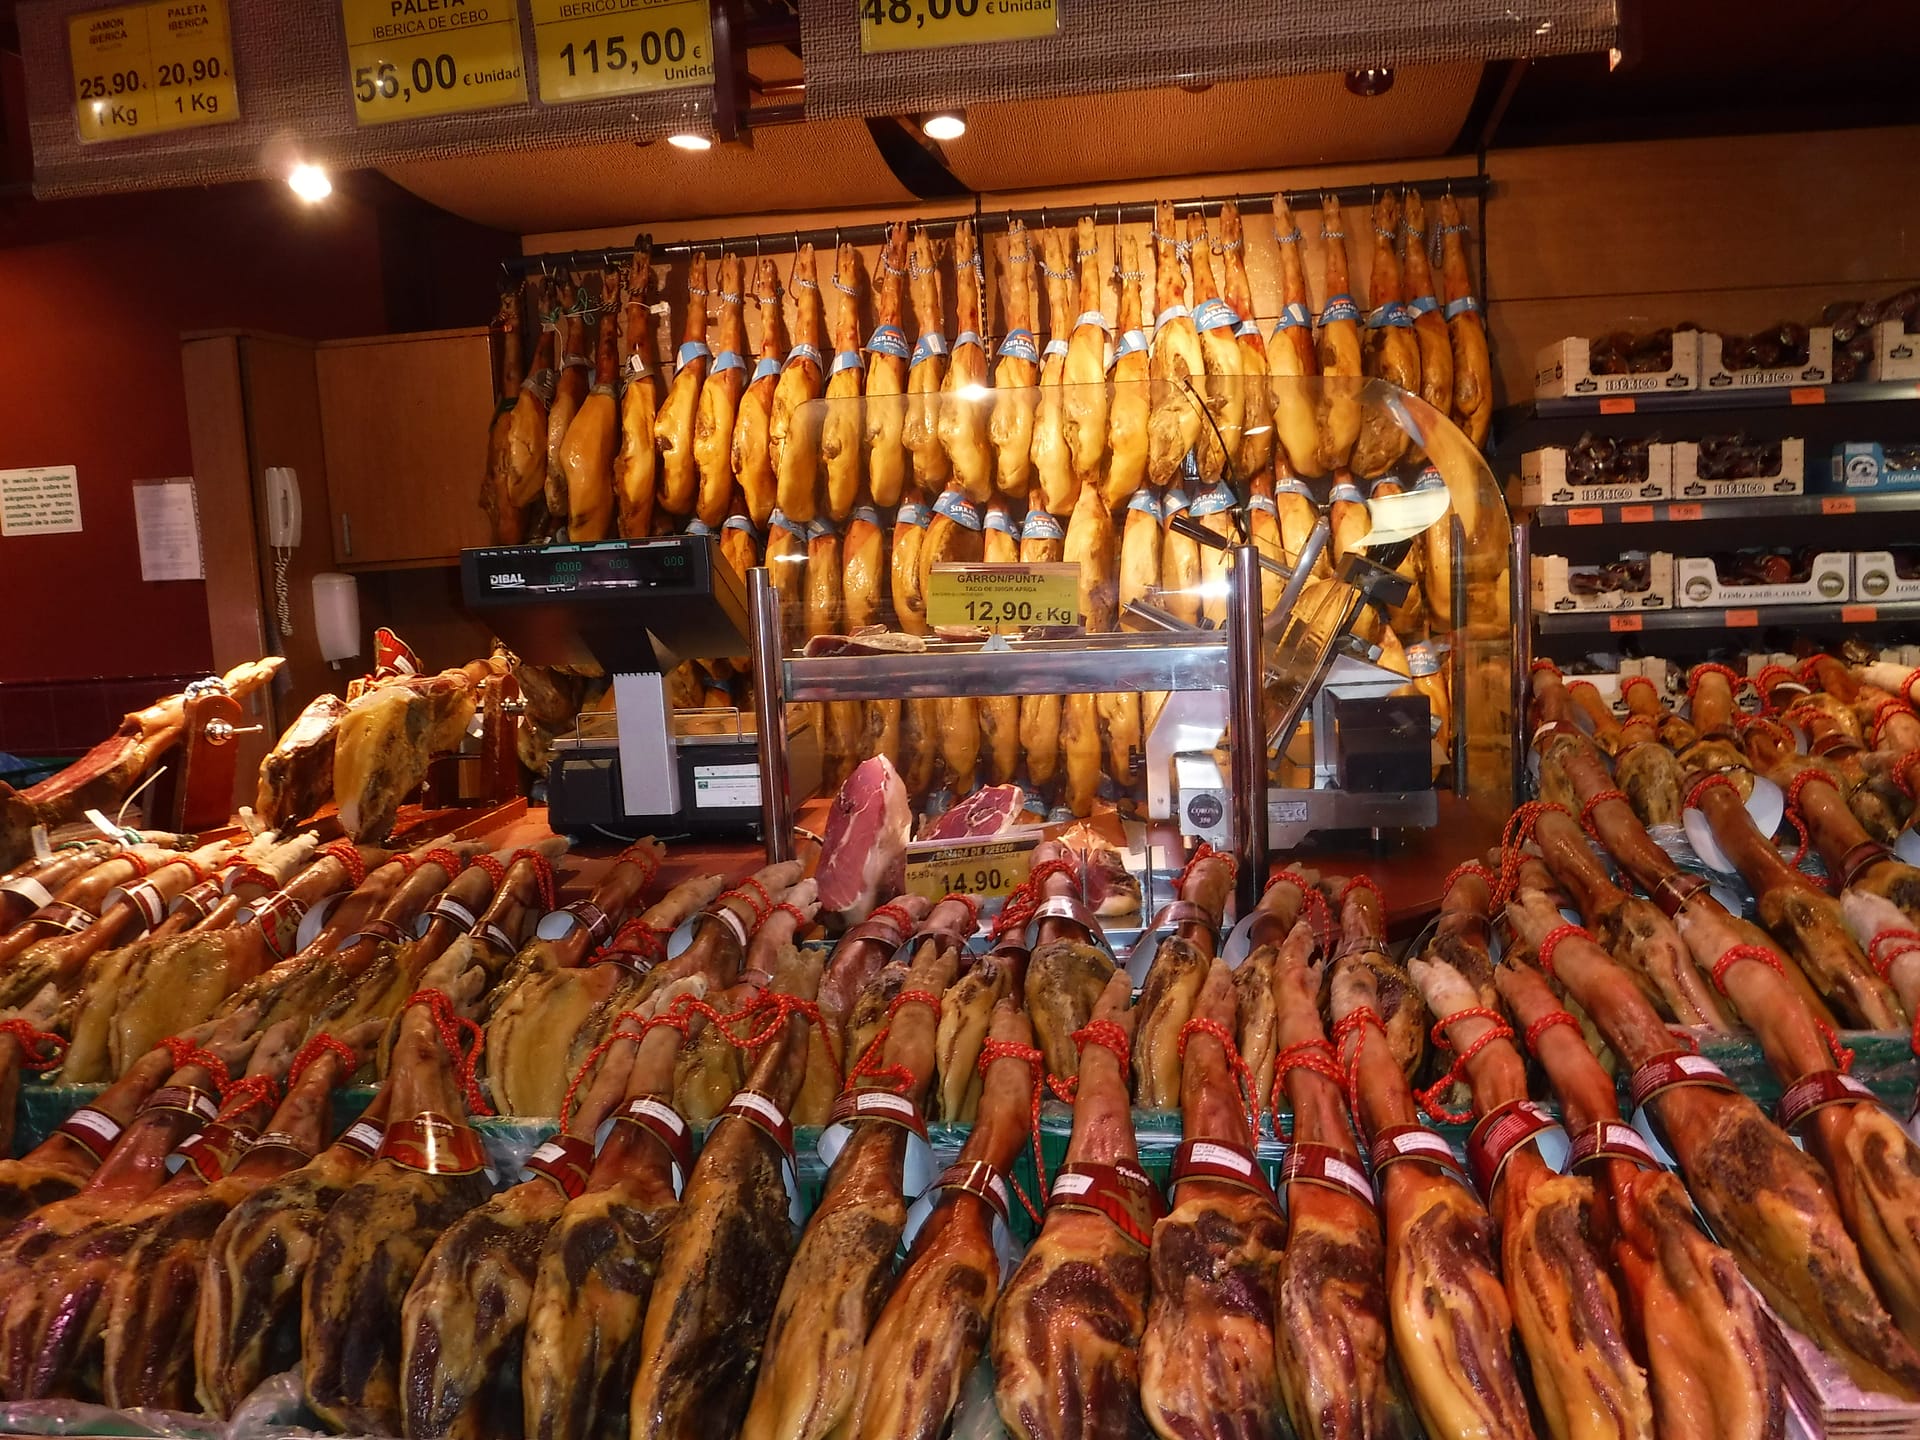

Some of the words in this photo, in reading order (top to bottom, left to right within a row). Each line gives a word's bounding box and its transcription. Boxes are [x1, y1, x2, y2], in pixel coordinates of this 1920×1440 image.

[168, 4, 207, 18] PALETA
[560, 0, 616, 17] IBERICO
[986, 1, 995, 15] €
[999, 0, 1052, 14] Unidad
[90, 18, 124, 32] JAMON
[168, 17, 209, 31] IBERICA
[373, 22, 425, 39] IBERICA
[428, 17, 447, 30] DE
[450, 9, 489, 26] CEBO
[89, 31, 127, 45] IBERICA
[560, 27, 686, 77] 115,00
[693, 45, 702, 59] €
[158, 57, 220, 87] 20,90
[356, 54, 457, 103] 56,00
[463, 74, 472, 86] €
[474, 65, 521, 85] Unidad
[175, 97, 183, 114] 1
[191, 93, 218, 114] Kg
[112, 105, 138, 126] Kg
[490, 573, 526, 585] DIBAL
[957, 574, 1046, 584] GARRON/PUNTA
[964, 600, 1032, 624] 12,90
[1035, 611, 1043, 621] €
[1047, 607, 1072, 624] Kg
[1004, 878, 1011, 888] €
